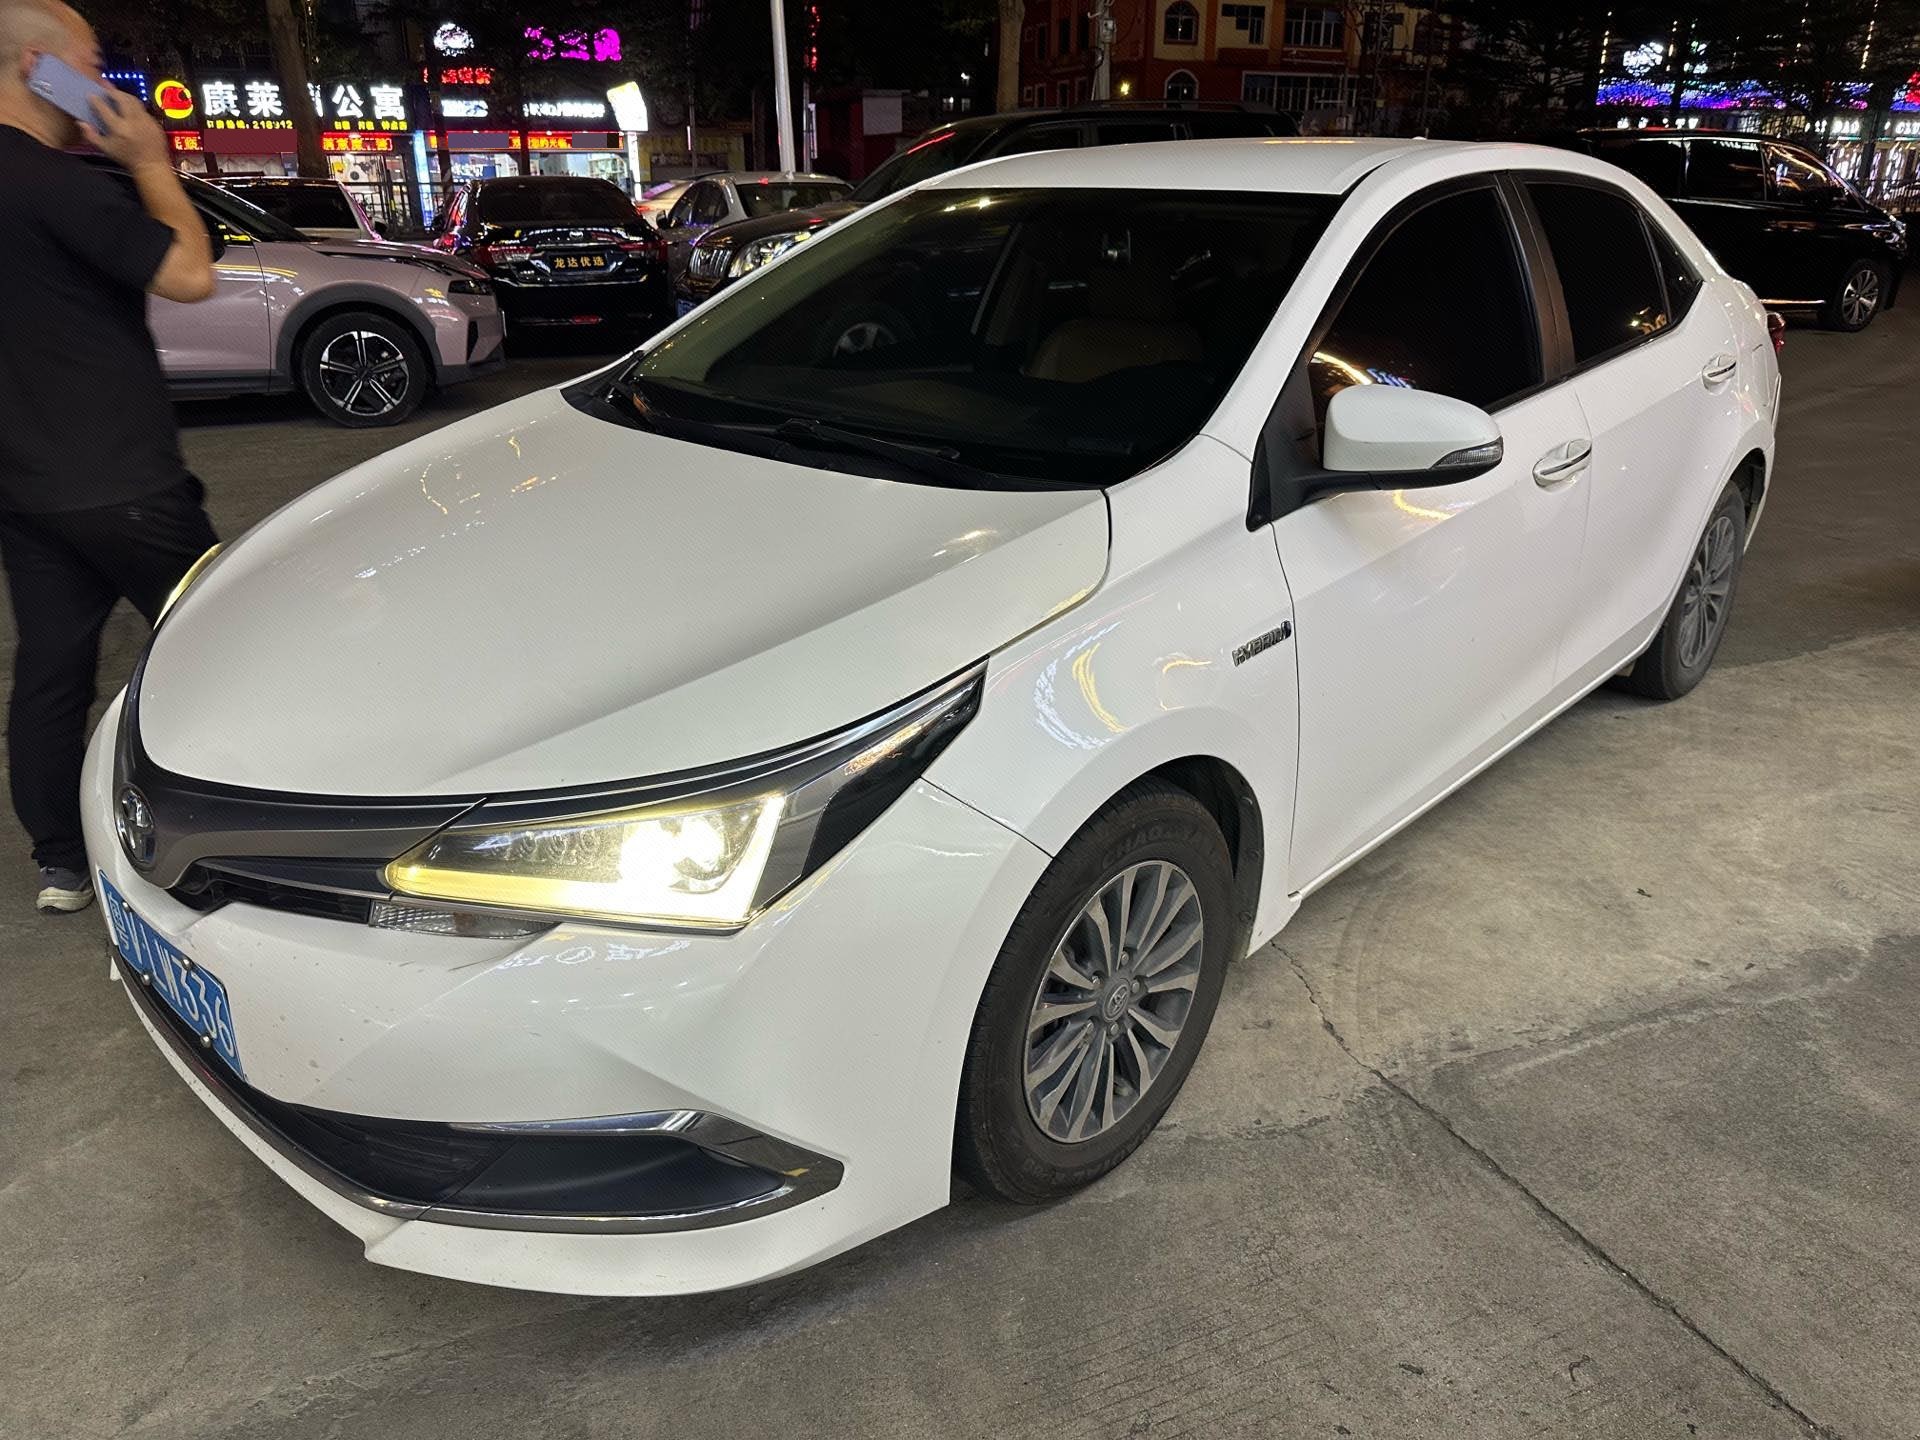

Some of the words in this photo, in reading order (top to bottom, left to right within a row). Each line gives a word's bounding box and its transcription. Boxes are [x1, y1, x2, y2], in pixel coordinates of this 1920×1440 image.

[553, 255, 606, 269] 龙达优选
[1232, 620, 1292, 667] HYBRID
